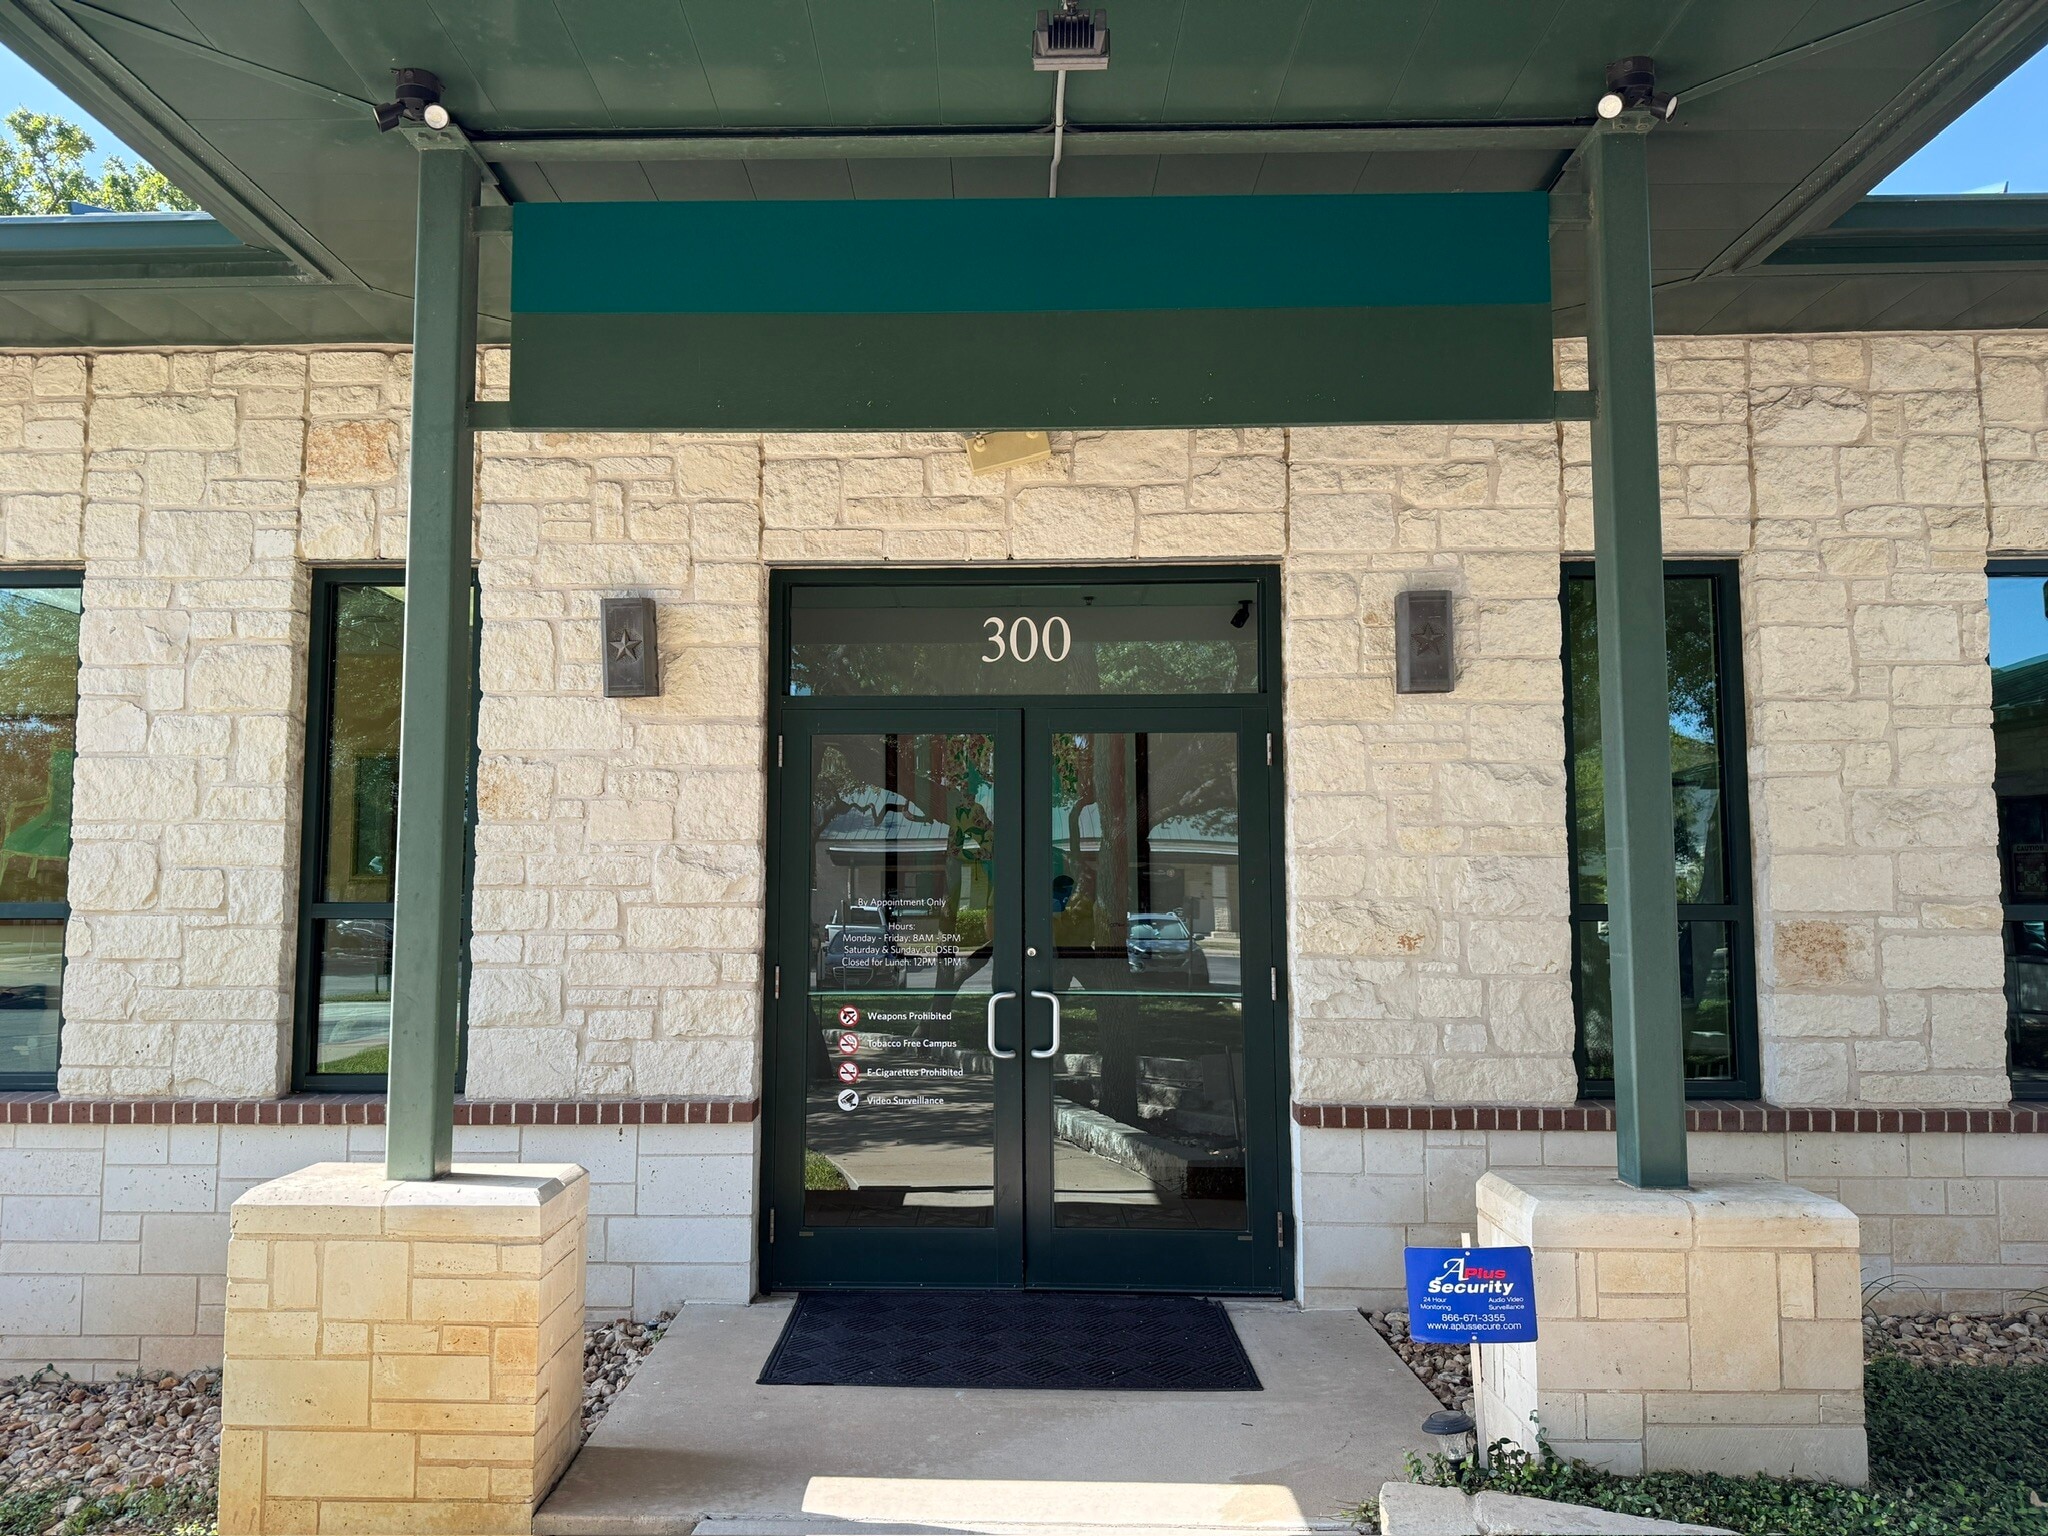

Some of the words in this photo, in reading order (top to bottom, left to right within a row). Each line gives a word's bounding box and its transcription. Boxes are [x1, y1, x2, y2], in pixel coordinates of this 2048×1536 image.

[981, 616, 1071, 663] 300
[858, 898, 868, 907] By
[870, 897, 924, 910] Appointment
[926, 897, 947, 909] Only
[888, 922, 916, 931] Hours:
[842, 934, 877, 943] Monday
[883, 933, 911, 943] Friday:
[912, 934, 934, 942] 8AM
[941, 934, 961, 942] 5PM
[844, 945, 880, 955] Saturday
[881, 946, 889, 954] &
[890, 945, 923, 955] Sunday:
[924, 945, 960, 954] CLOSED
[841, 957, 870, 966] Closed
[871, 957, 883, 966] for
[884, 957, 912, 966] Lunch:
[914, 957, 937, 966] 12PM
[944, 957, 962, 966] 1PM
[867, 1012, 908, 1021] Weapons
[909, 1011, 952, 1020] Prohibited
[867, 1039, 902, 1048] Tobacco
[903, 1039, 921, 1048] Free
[923, 1039, 957, 1049] Campus
[867, 1068, 919, 1078] E-Cigarettes
[920, 1068, 964, 1077] Prohibited
[867, 1096, 892, 1105] Video
[893, 1096, 944, 1105] Surveillance
[1428, 1280, 1515, 1296] Security
[1420, 1303, 1452, 1311] Monitoring
[1488, 1303, 1525, 1311] Surveillance
[1441, 1313, 1506, 1322] 866-671-3355
[1427, 1322, 1522, 1331] www.aplussecure.com
